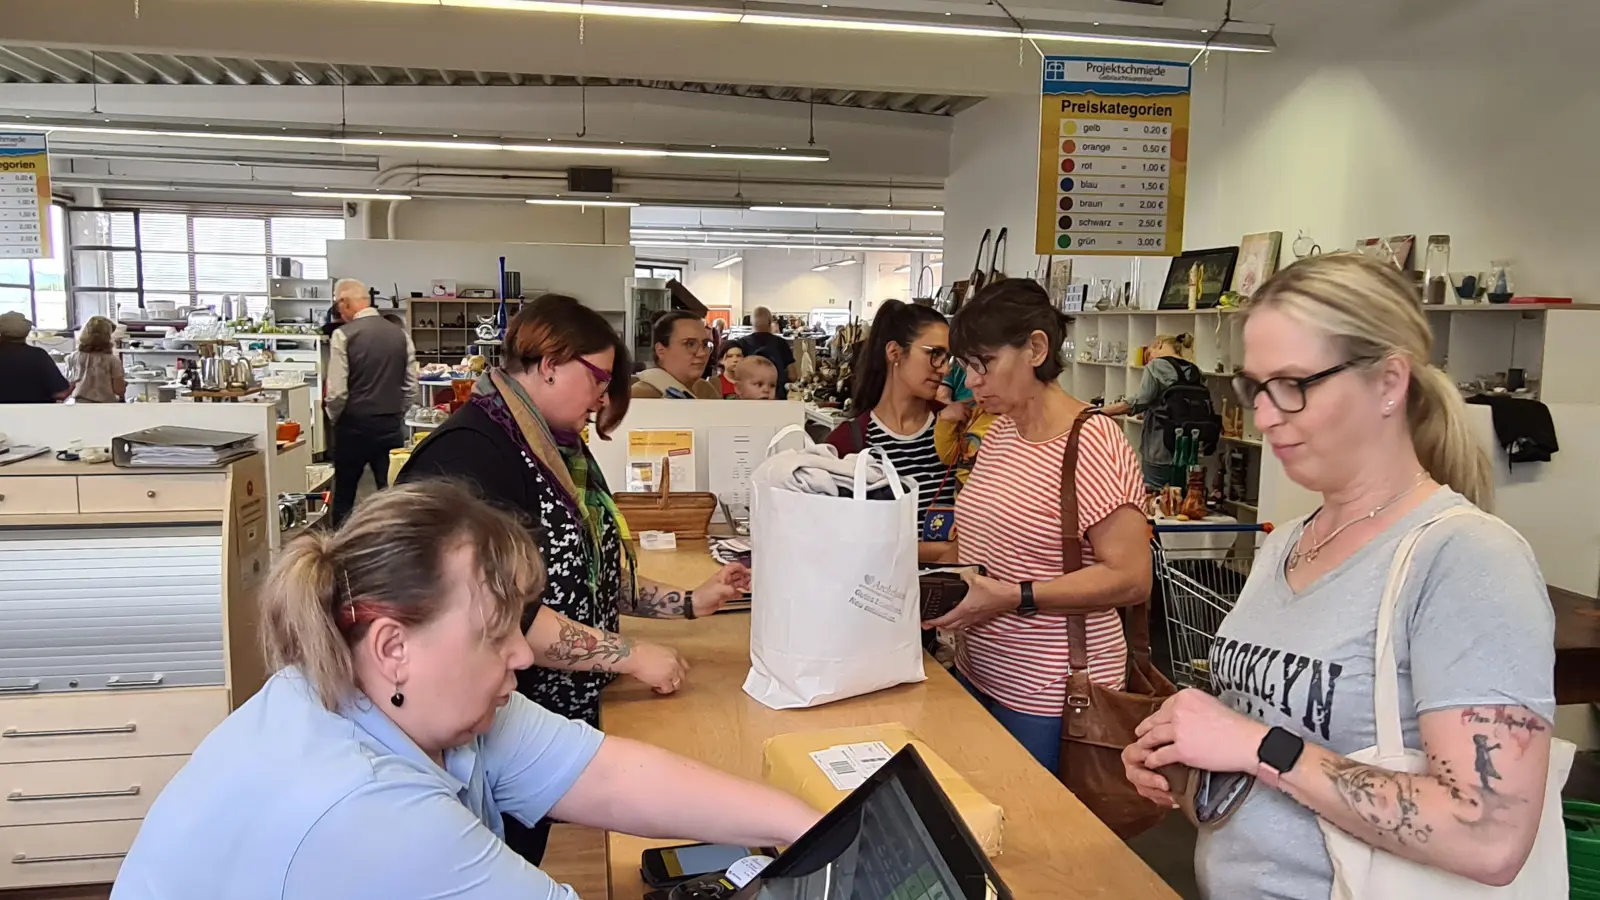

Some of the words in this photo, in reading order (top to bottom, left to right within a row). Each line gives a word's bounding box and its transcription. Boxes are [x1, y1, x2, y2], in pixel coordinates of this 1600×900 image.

[1086, 62, 1166, 77] Projektschmiede
[1061, 99, 1173, 118] Preiskategorien
[1083, 124, 1101, 132] gelb
[1082, 142, 1111, 152] orange
[1081, 162, 1093, 170] rot
[1080, 180, 1098, 189] blau
[1079, 200, 1103, 208] braun
[1078, 218, 1112, 227] schwarz
[1077, 237, 1096, 247] grün
[1209, 637, 1343, 741] ROOKLYN
